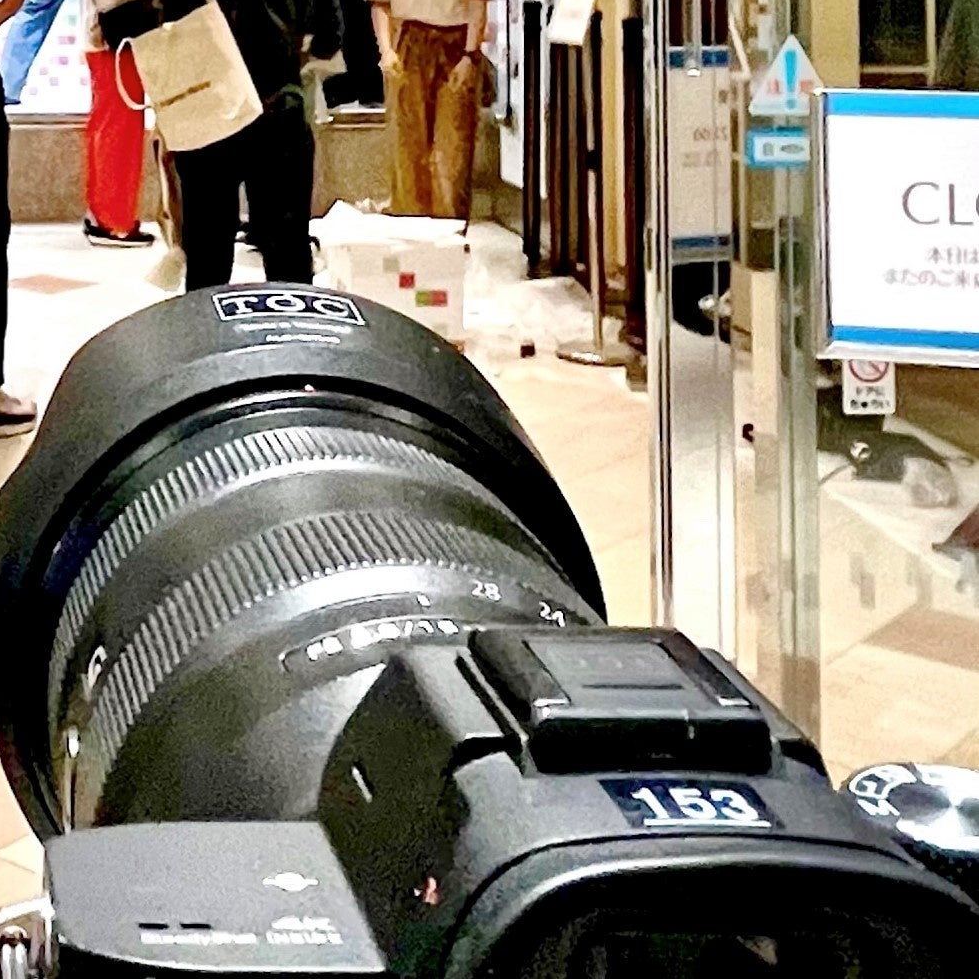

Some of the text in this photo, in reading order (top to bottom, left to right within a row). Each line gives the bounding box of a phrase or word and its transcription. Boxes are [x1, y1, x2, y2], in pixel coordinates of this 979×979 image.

[901, 180, 979, 226] CL
[470, 578, 501, 601] 28
[630, 786, 759, 821] 153
